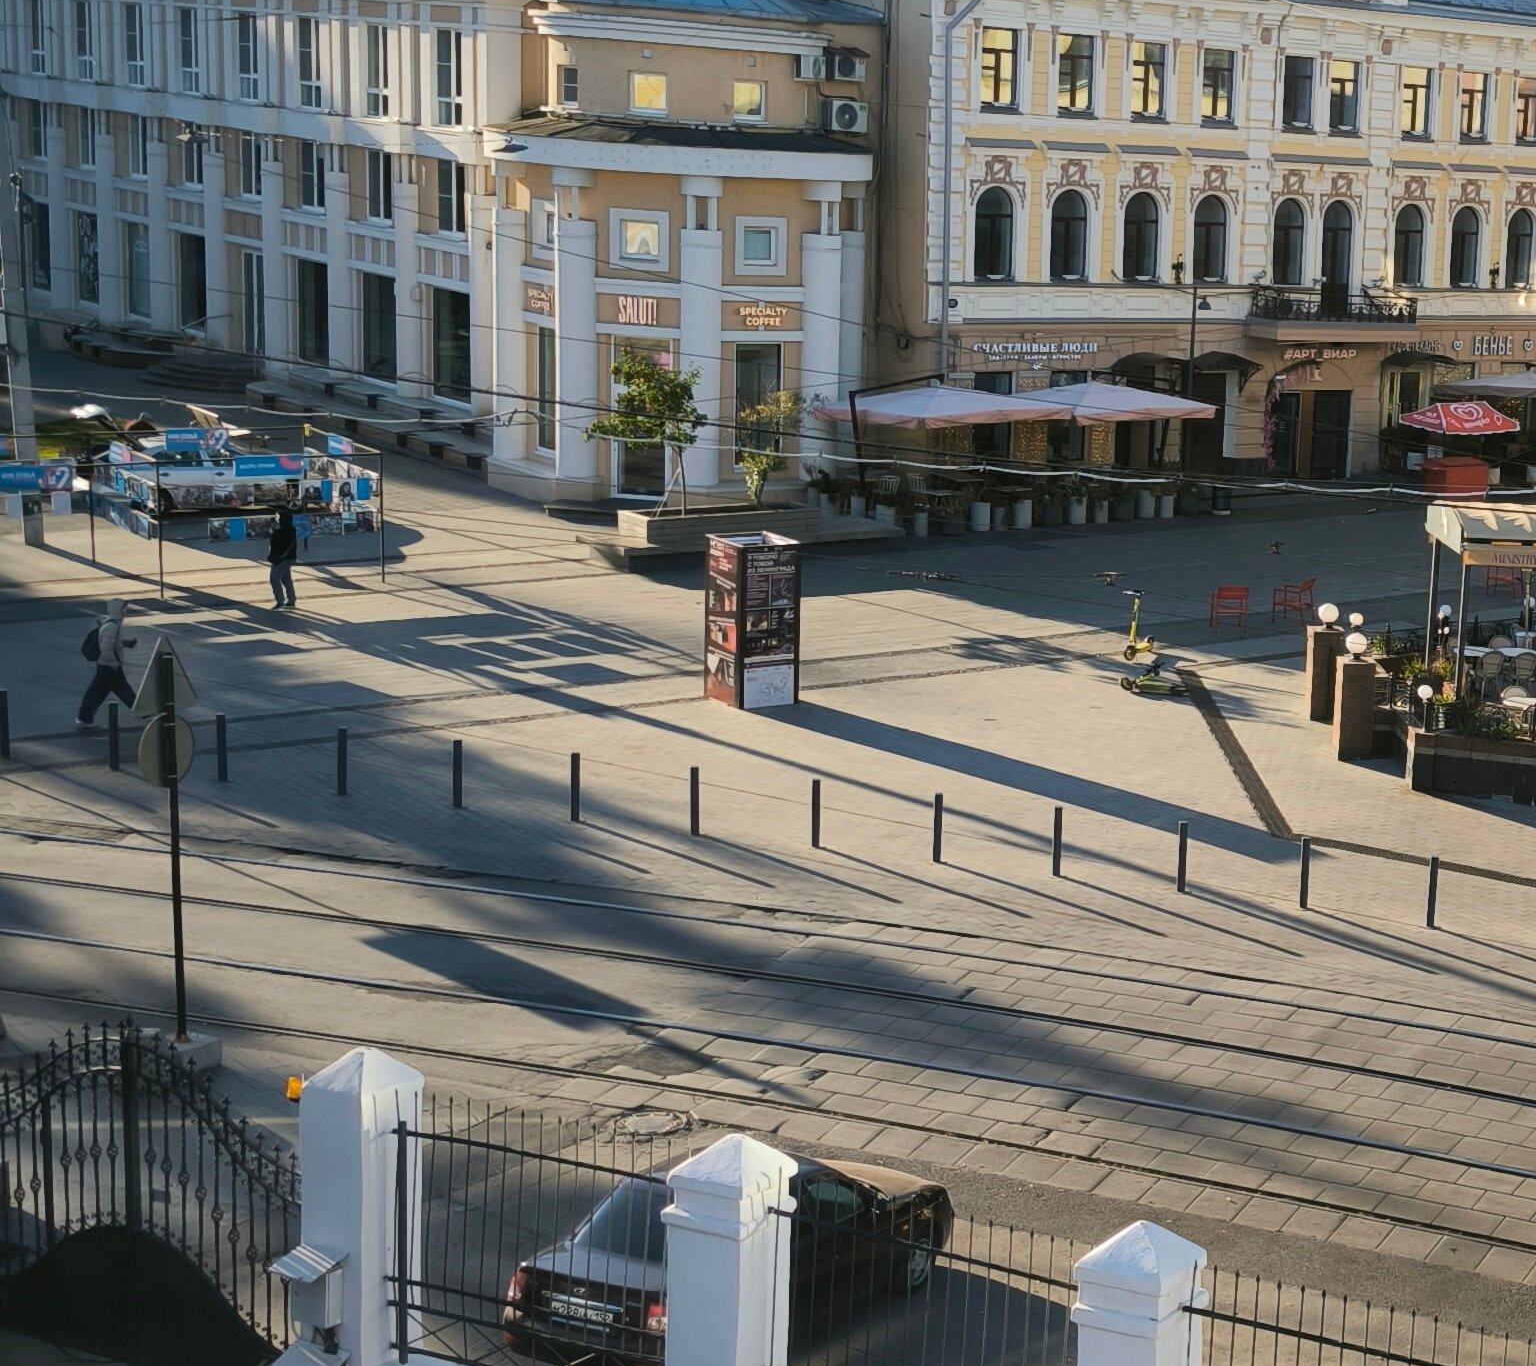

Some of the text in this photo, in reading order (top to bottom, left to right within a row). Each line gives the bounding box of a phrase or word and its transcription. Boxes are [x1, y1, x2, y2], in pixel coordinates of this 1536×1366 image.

[618, 296, 657, 325] SALUT!
[740, 306, 787, 316] SPECIALTY
[745, 317, 781, 326] COFFEE
[973, 342, 1098, 353] СЧАСТЛИВЫЕ ЛЮДИ
[1474, 336, 1513, 356] БЕНЬЕ
[1492, 553, 1536, 565] MINISTRY
